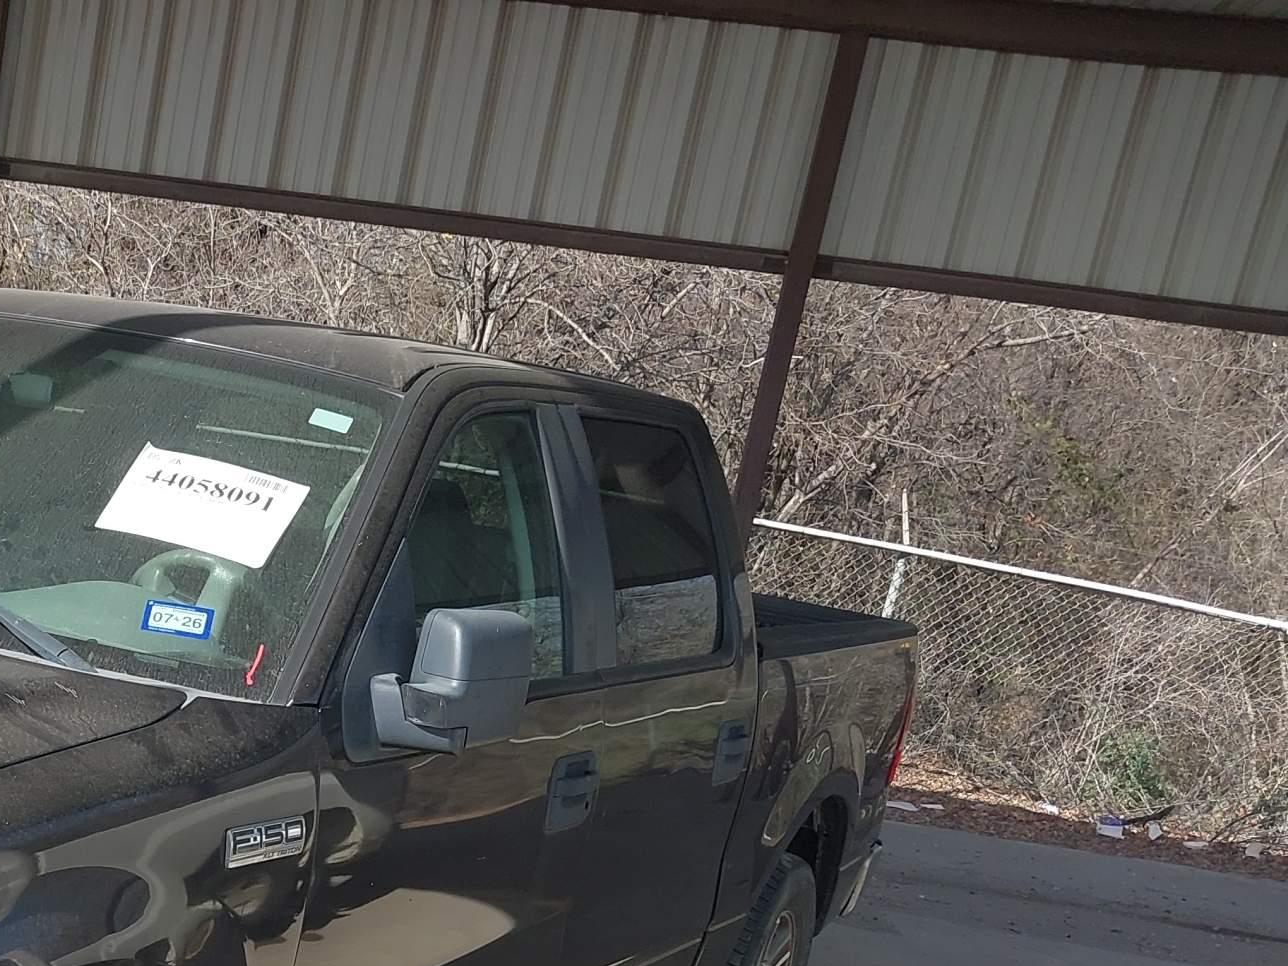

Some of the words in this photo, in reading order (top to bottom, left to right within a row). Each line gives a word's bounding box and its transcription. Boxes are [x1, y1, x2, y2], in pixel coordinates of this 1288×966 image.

[145, 469, 274, 512] 44058091
[152, 611, 174, 624] 07
[181, 616, 203, 629] 26
